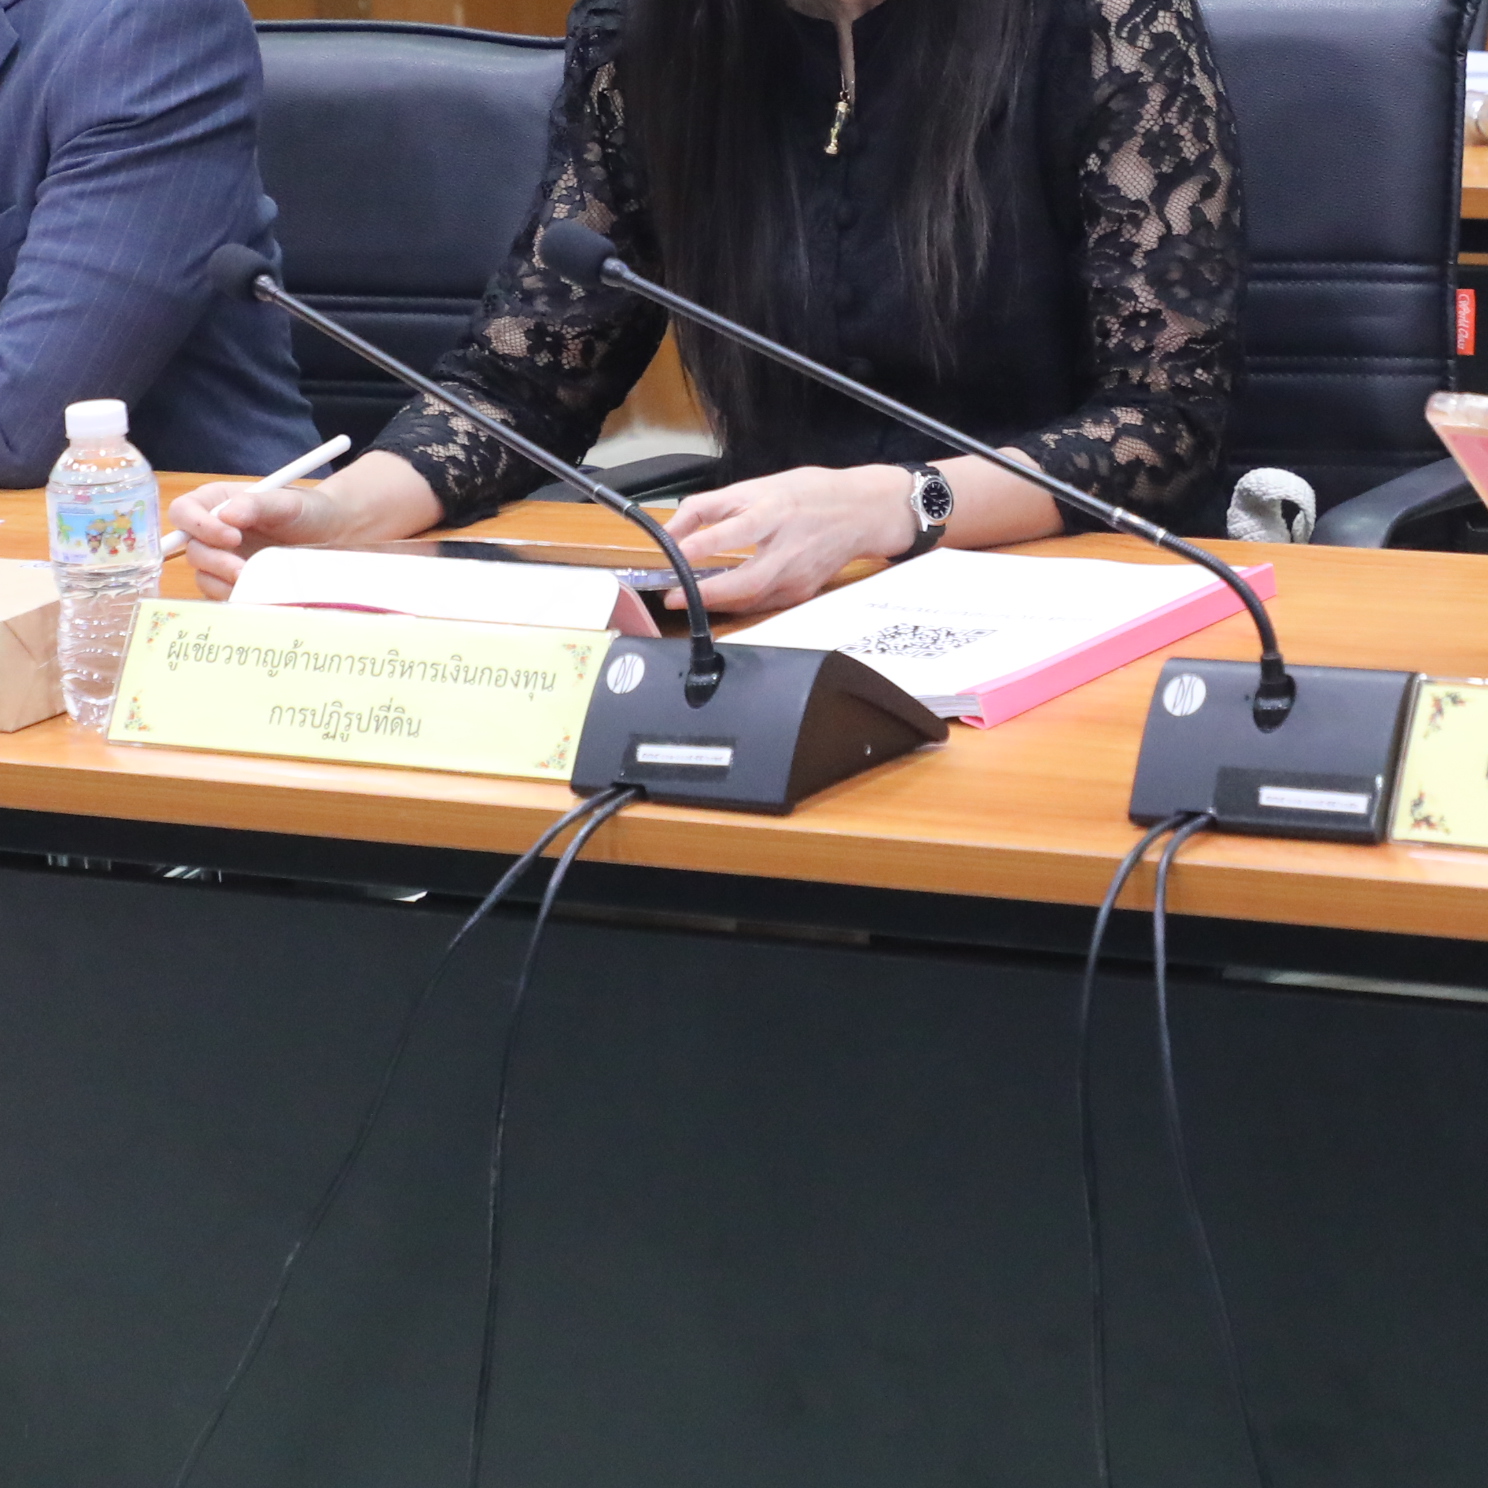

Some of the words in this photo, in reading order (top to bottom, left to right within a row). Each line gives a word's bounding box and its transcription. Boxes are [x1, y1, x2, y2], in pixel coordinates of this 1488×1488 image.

[166, 626, 557, 702] ผู้เชี่ยวชาญด้านการบริหารเงินกองทุน
[268, 697, 422, 743] การปฏิรูปที่ดิน
